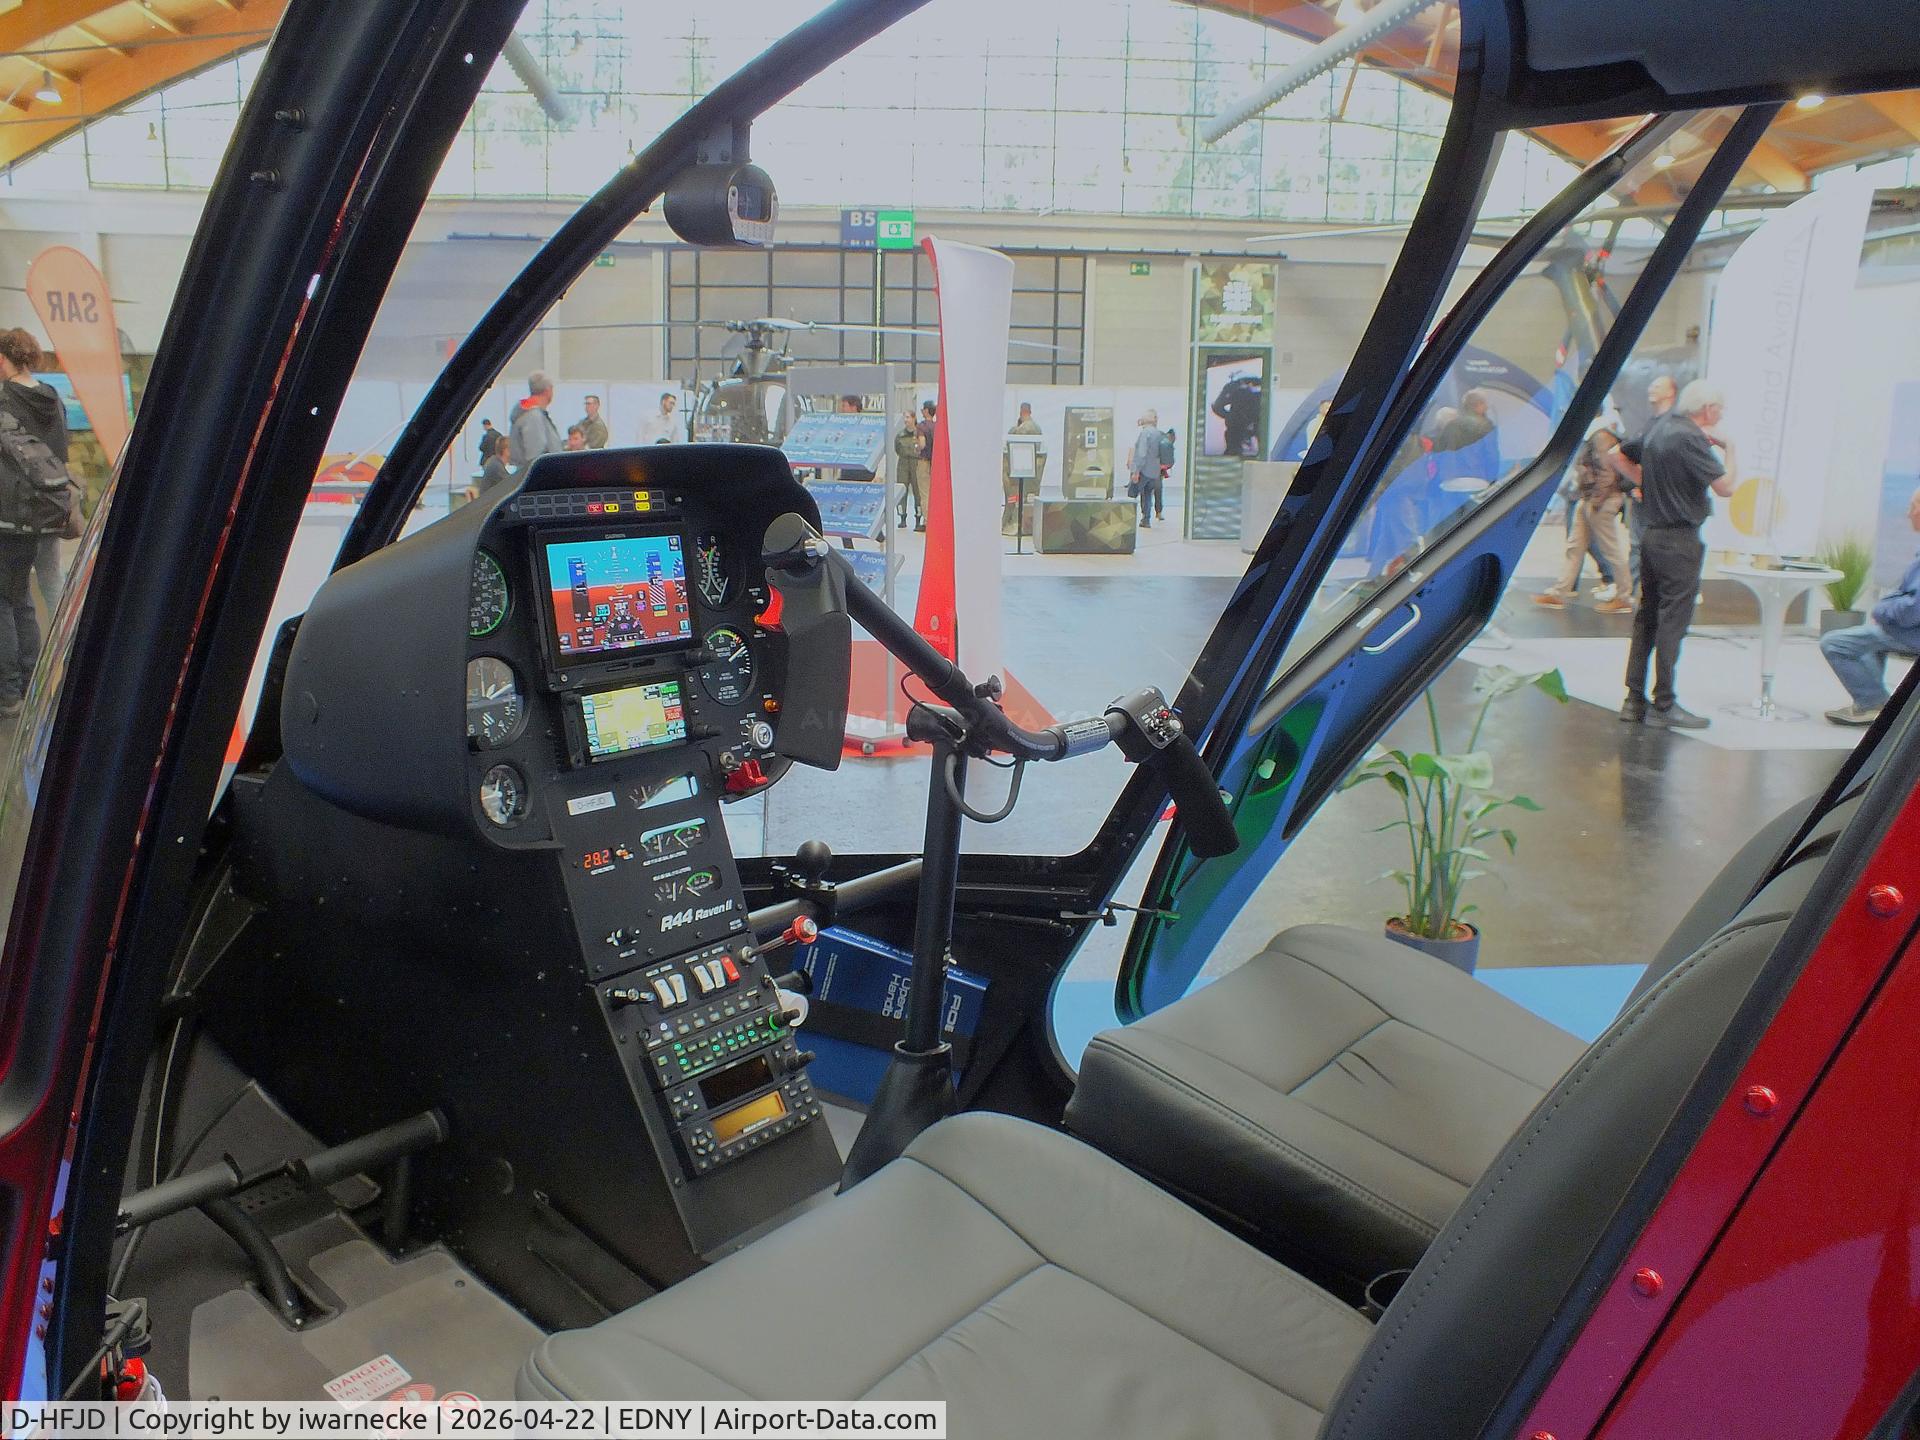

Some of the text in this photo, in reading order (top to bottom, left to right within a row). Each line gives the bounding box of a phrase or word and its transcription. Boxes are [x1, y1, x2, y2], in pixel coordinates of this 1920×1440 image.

[850, 211, 876, 227] B5
[1751, 370, 1784, 473] Holland
[504, 706, 511, 716] 3
[661, 908, 693, 933] R44
[695, 904, 726, 921] Raven
[330, 1359, 390, 1393] DANGER
